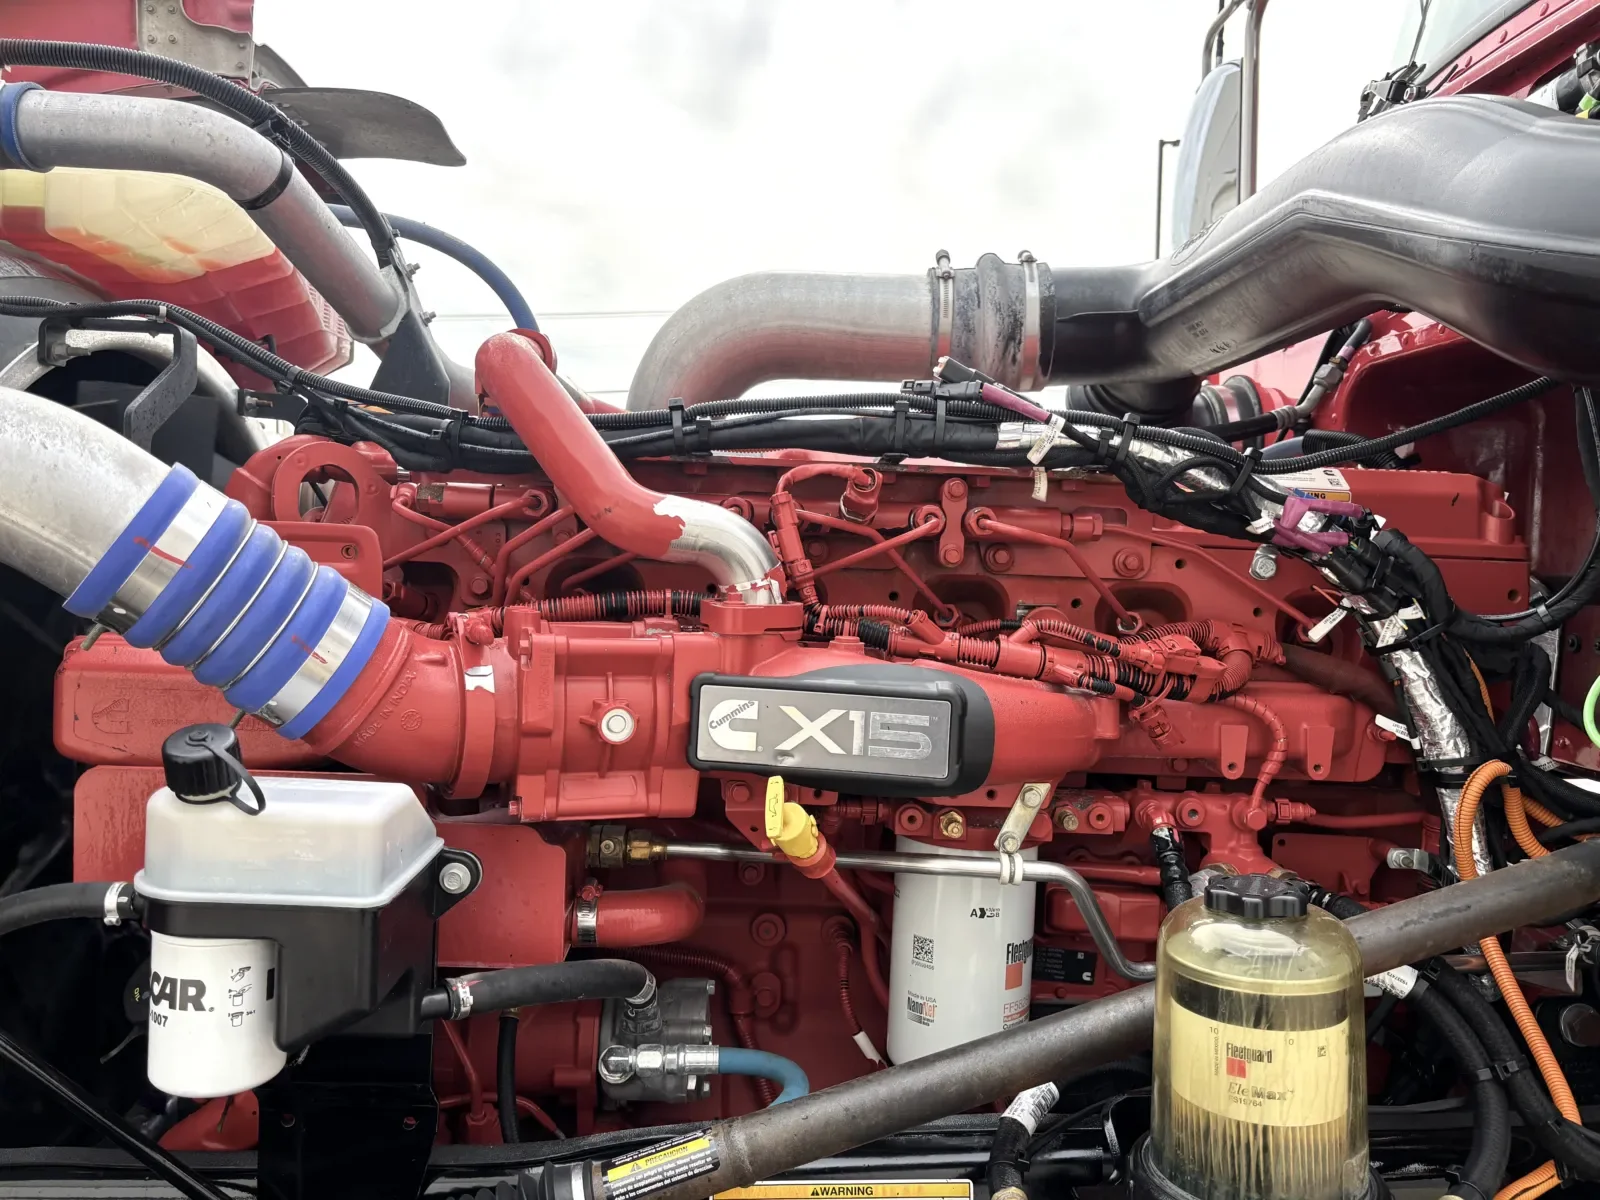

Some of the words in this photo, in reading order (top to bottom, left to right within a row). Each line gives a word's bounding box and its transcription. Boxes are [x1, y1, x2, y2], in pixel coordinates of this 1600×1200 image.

[380, 707, 394, 719] IN
[709, 699, 755, 730] Cummins
[774, 705, 932, 760] X15
[970, 908, 978, 918] A
[1209, 1026, 1219, 1034] 10
[1226, 1042, 1273, 1064] Fleetguard
[645, 1146, 688, 1166] PRECAUCION
[820, 1186, 874, 1196] WARNING
